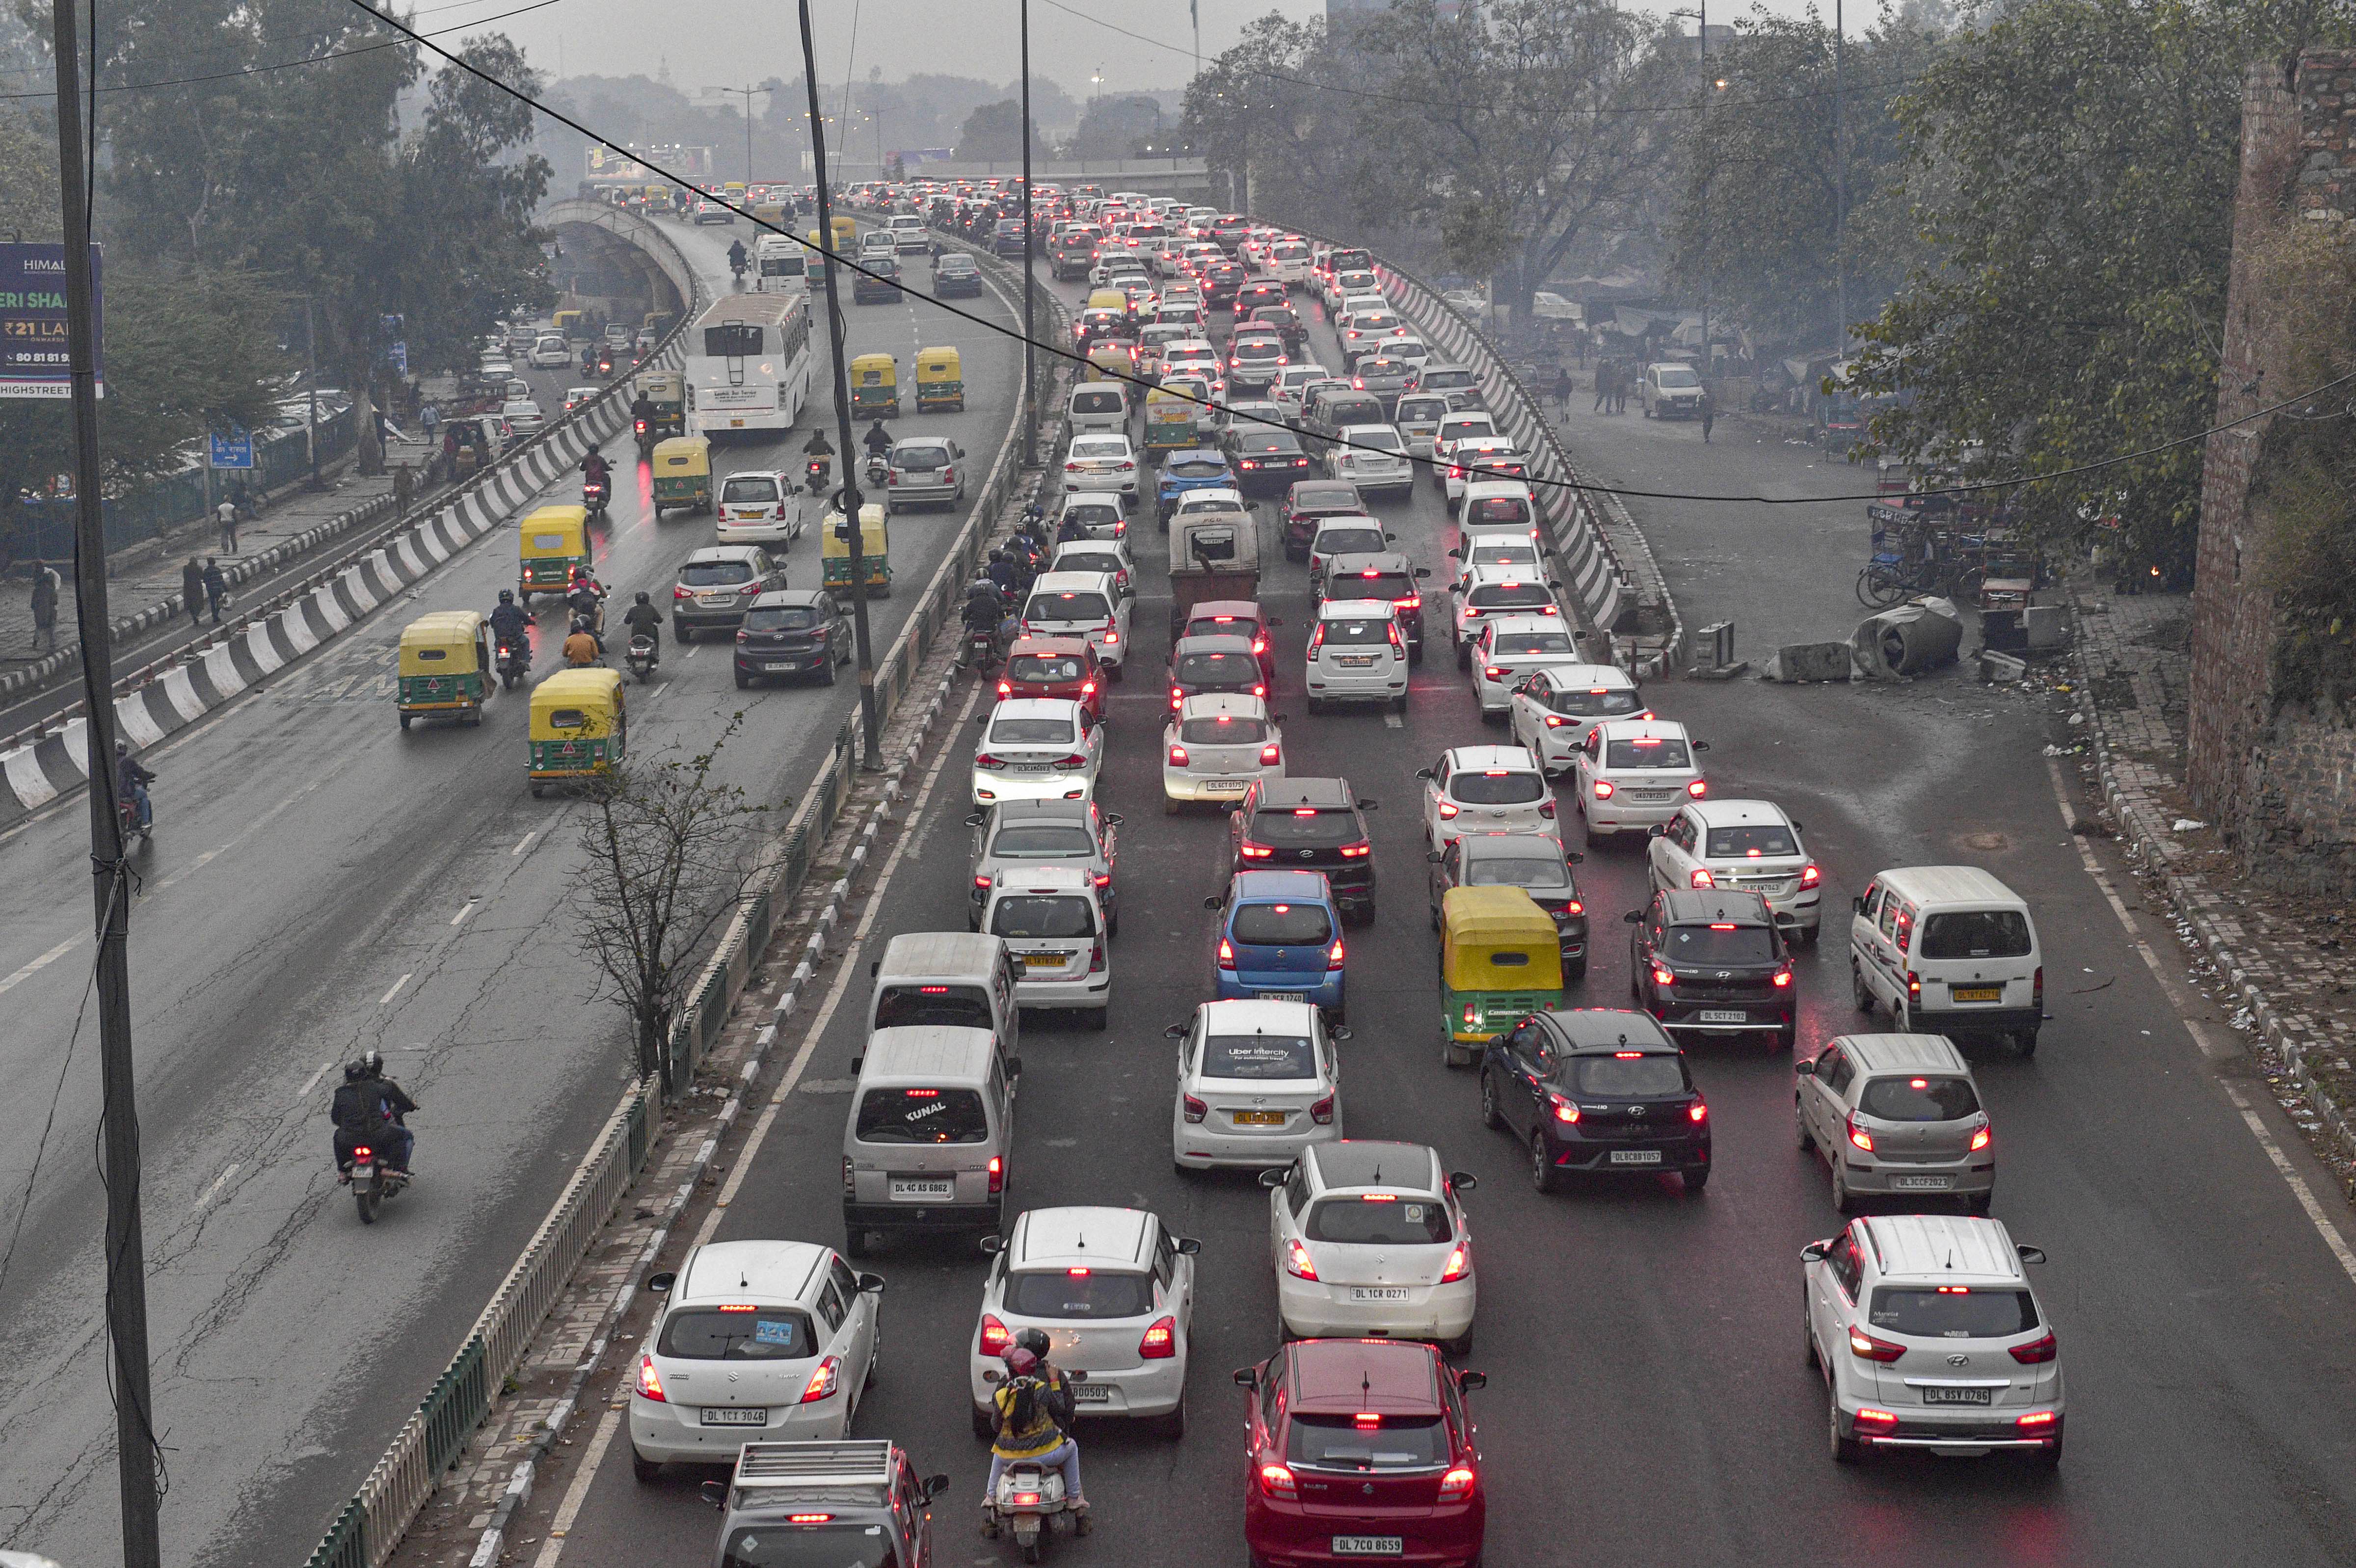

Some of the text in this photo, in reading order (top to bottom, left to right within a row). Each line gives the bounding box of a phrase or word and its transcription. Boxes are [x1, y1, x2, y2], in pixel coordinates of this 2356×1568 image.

[27, 292, 67, 308] SHA
[42, 322, 68, 335] LA
[16, 353, 70, 362] 80 81 81 9
[1254, 1048, 1289, 1057] Intercity
[905, 1102, 946, 1121] KUNAL
[929, 1184, 947, 1192] 6862
[1356, 1289, 1406, 1299] DL 1CR 0271
[1930, 1388, 1987, 1401] DL 8SV 0786
[708, 1411, 721, 1421] DL
[742, 1411, 764, 1421] 3046
[1339, 1540, 1351, 1550] DL
[1375, 1540, 1400, 1551] 8659
